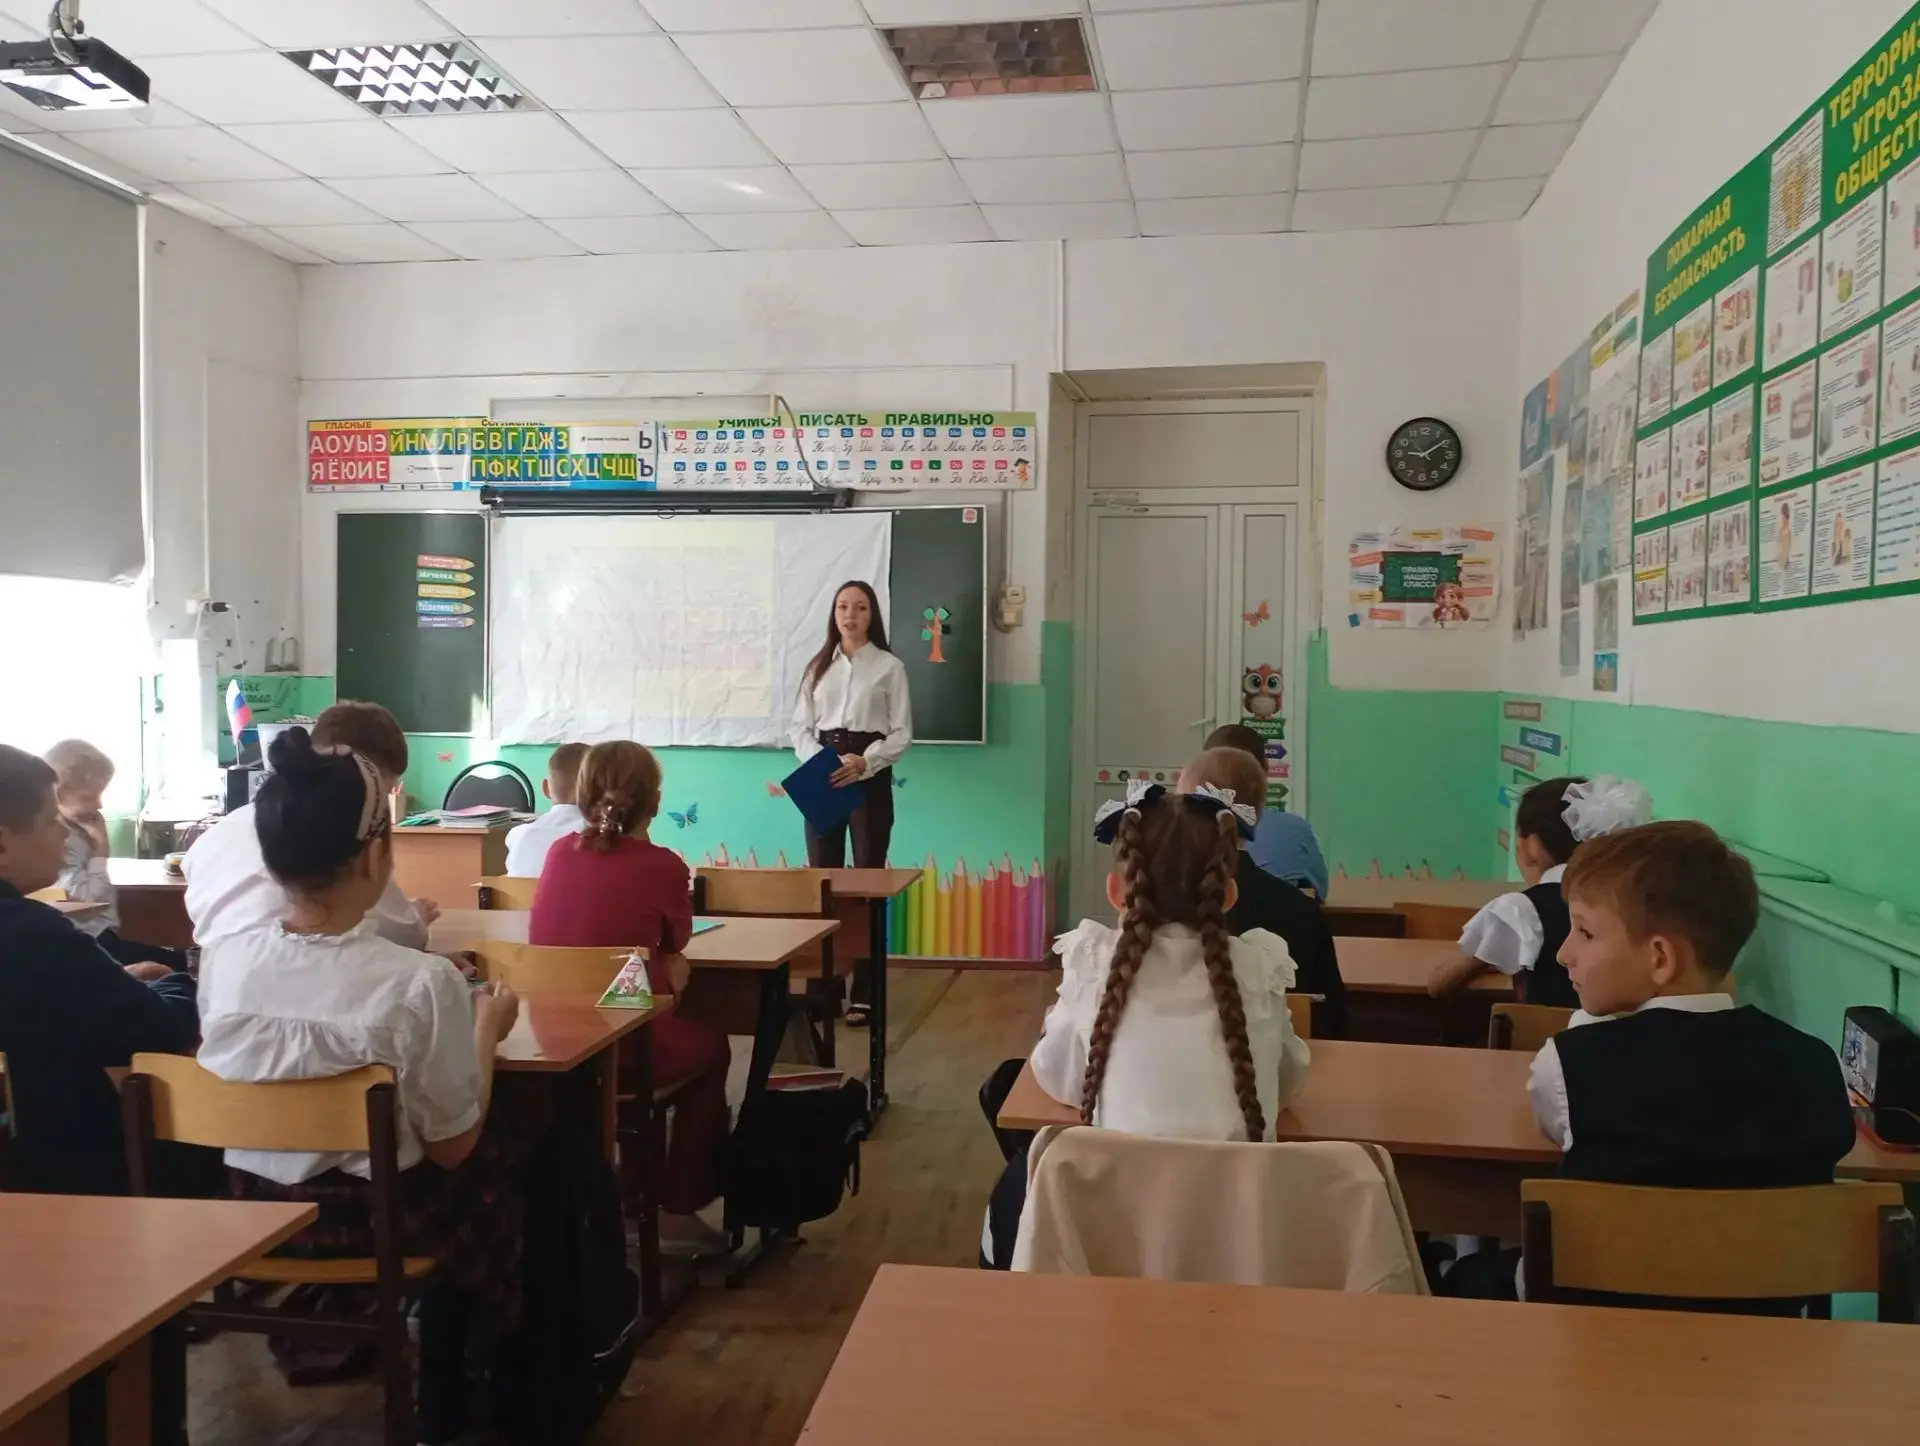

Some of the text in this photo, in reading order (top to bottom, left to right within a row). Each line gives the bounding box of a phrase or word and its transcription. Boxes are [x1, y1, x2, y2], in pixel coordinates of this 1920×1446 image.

[1829, 18, 1920, 128] ТЕРРОРИ
[1835, 108, 1920, 205] ОБЩЕСТ
[1654, 226, 1746, 317] БЕЗОПАСНОСТЬ
[1667, 195, 1732, 272] ПОЖАРНАЯ
[325, 421, 373, 430] ГЛАСНЫЕ
[718, 413, 995, 428] УЧИМСЯ ПИСАТЬ ПРАВИЛЬНО
